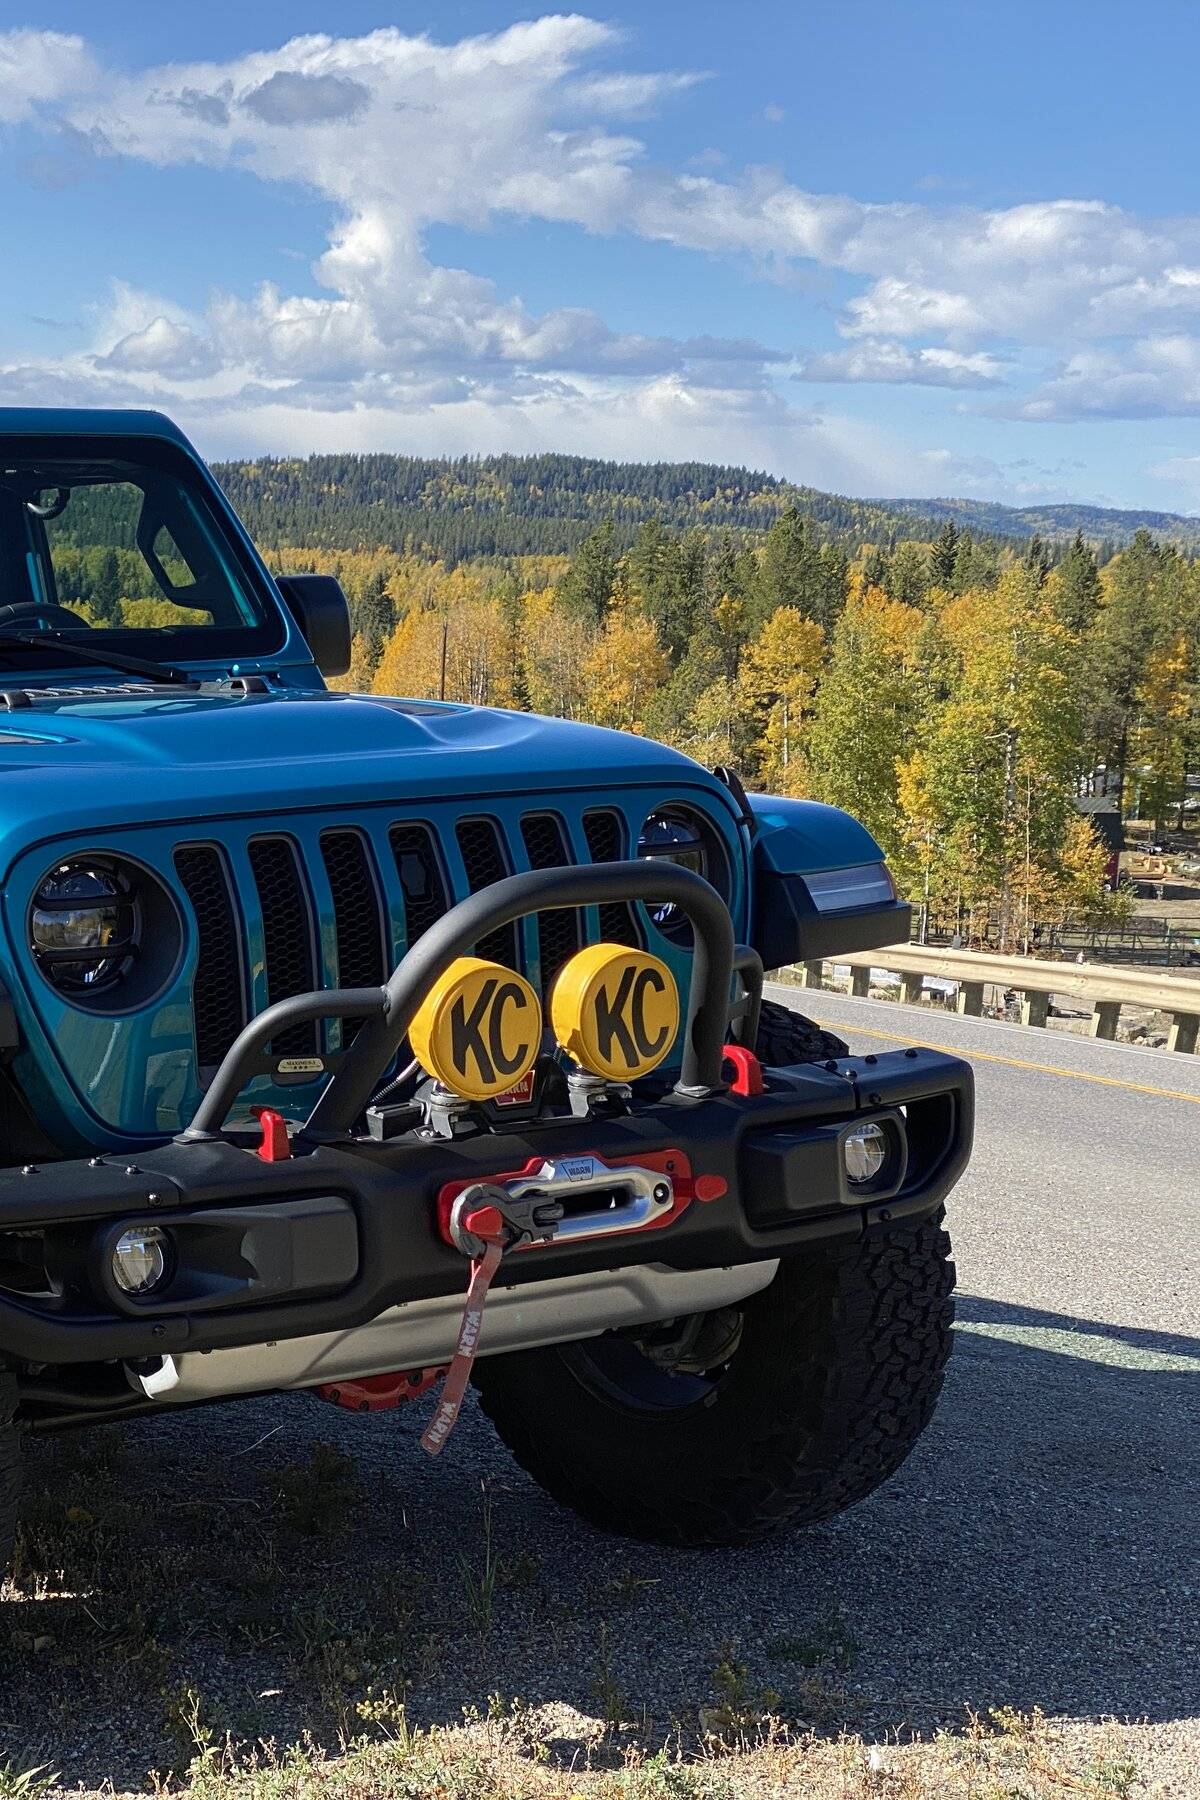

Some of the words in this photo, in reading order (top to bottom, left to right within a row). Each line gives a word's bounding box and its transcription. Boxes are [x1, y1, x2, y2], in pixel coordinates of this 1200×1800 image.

[450, 979, 528, 1084] KC
[594, 966, 670, 1068] KC
[568, 1165, 591, 1177] WARN
